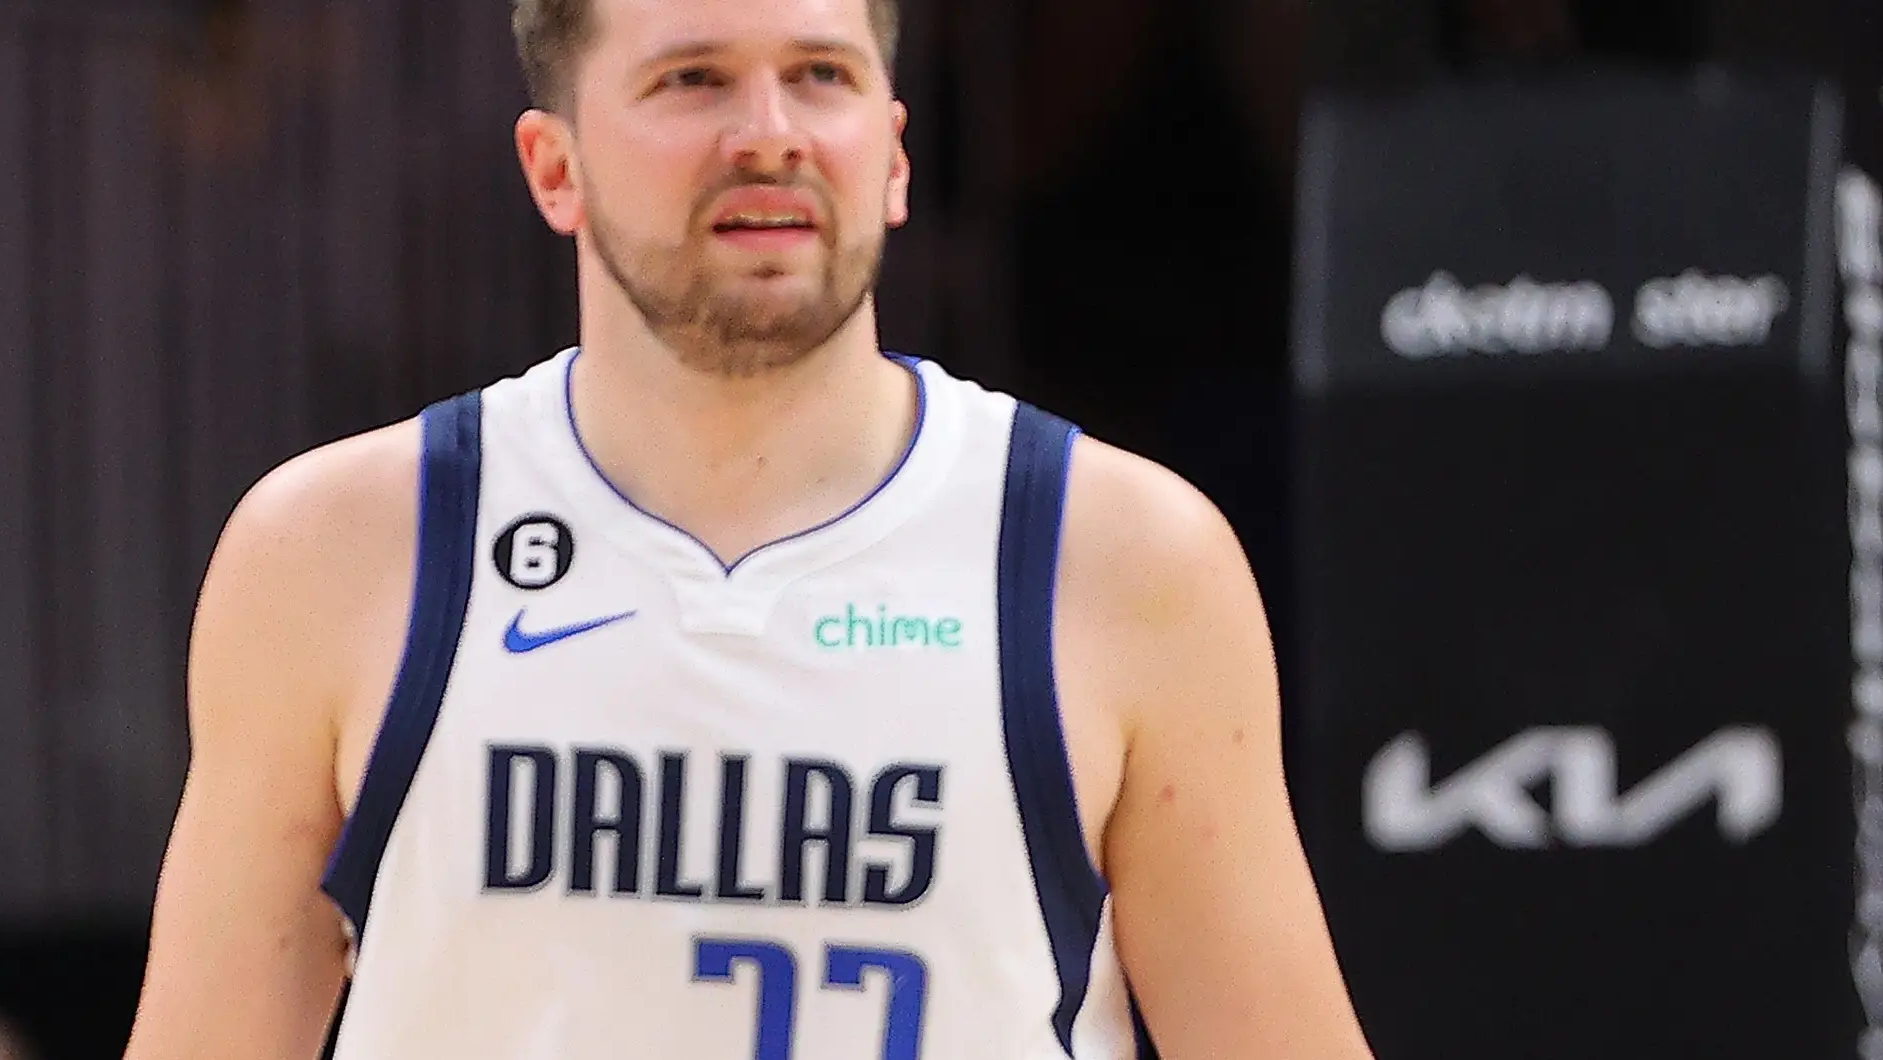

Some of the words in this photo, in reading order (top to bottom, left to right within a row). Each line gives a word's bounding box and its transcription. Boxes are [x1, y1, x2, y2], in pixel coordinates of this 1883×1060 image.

[509, 522, 559, 583] 6
[814, 604, 963, 649] chime
[481, 741, 945, 911] DALLAS
